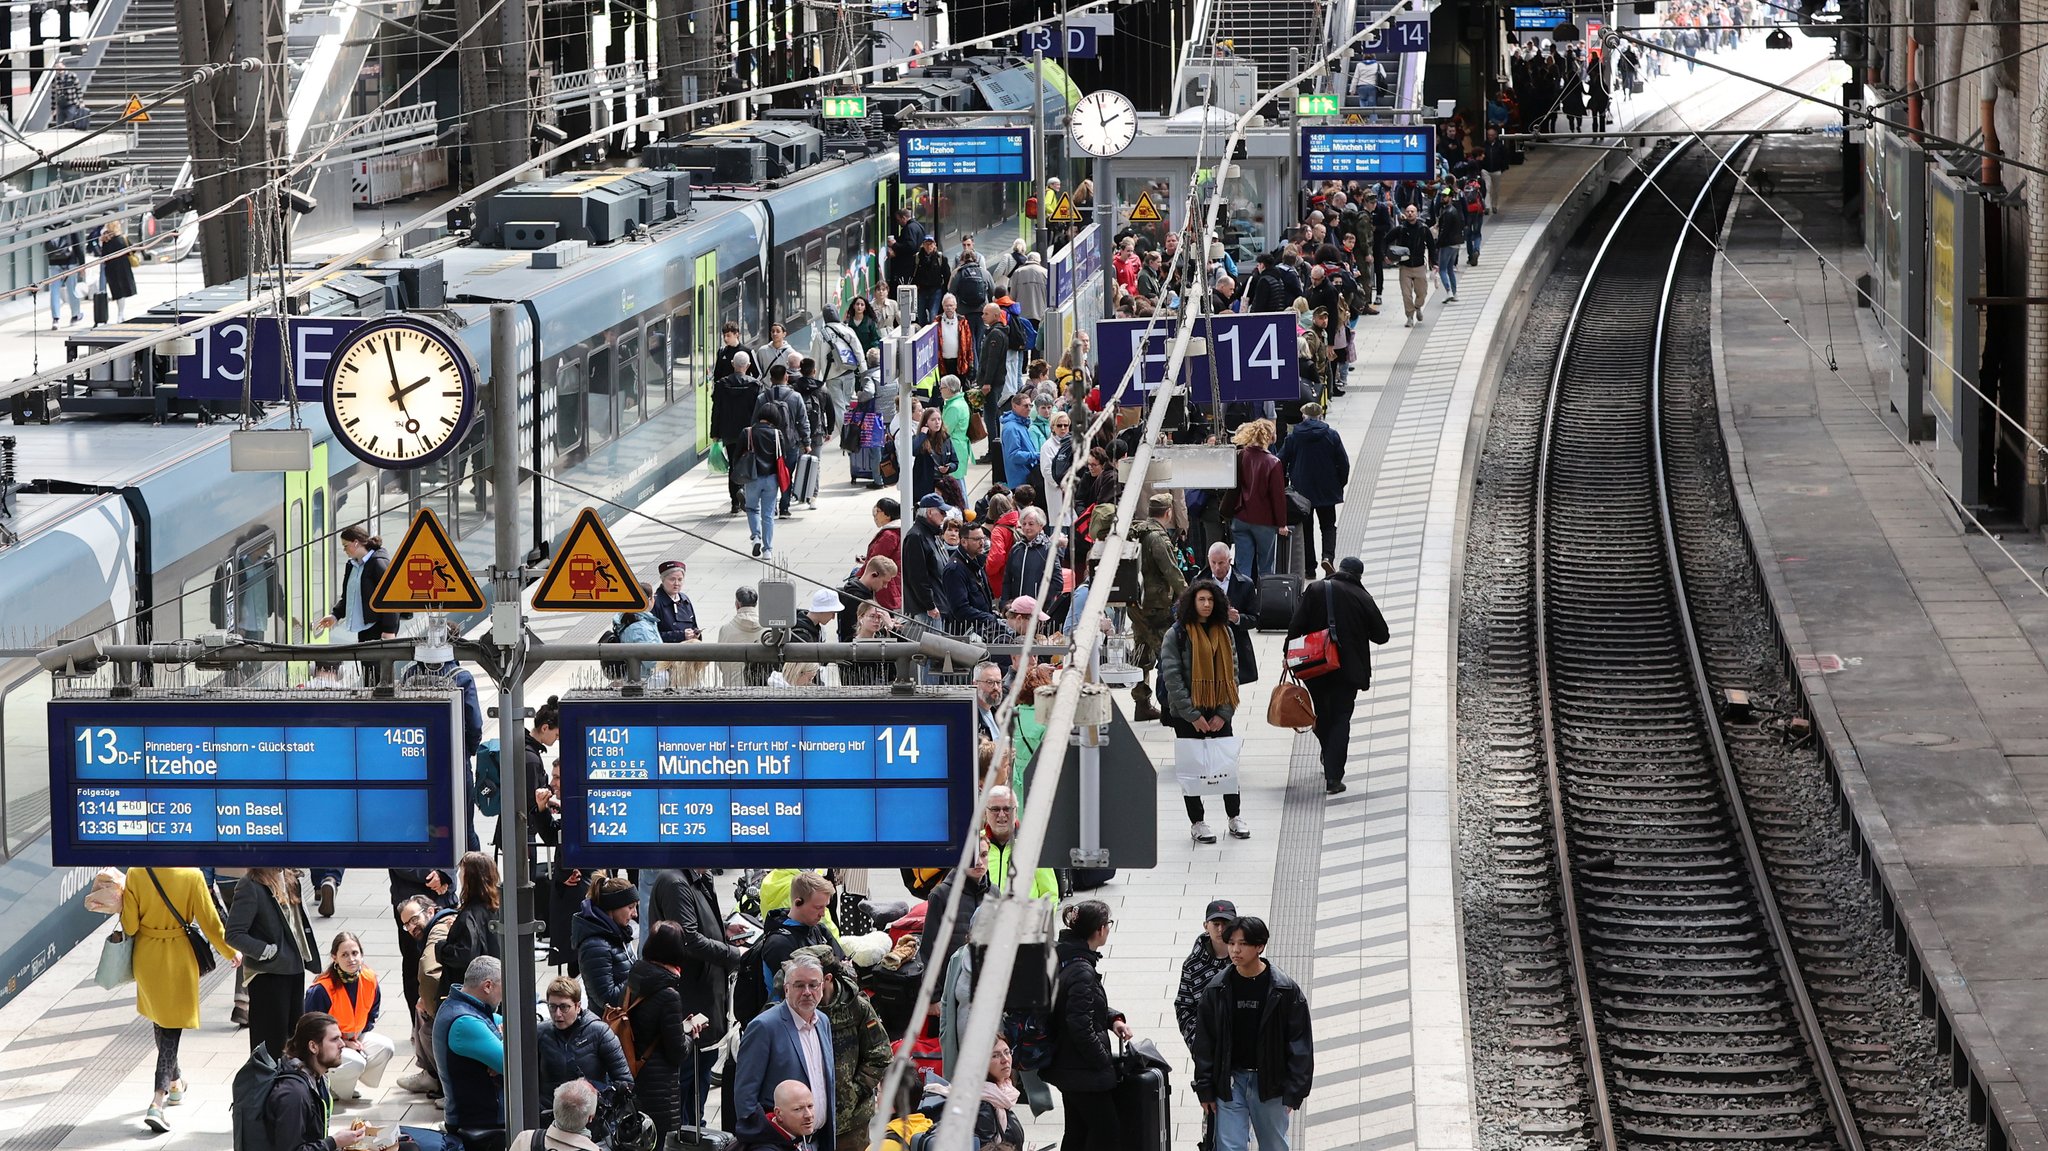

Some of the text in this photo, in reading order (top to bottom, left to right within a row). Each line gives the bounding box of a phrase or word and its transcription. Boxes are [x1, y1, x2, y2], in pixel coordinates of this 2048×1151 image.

[1030, 28, 1085, 52] 13 D
[1398, 23, 1424, 46] 14
[907, 138, 922, 151] 13
[1403, 134, 1418, 148] 14
[195, 324, 334, 386] 13 E
[1131, 323, 1286, 391] E 14
[226, 562, 234, 598] 2
[384, 729, 424, 745] 14:06
[588, 728, 629, 745] 14:01
[77, 728, 141, 765] 13 D-F
[145, 742, 193, 753] Pinneberg
[203, 742, 248, 752] Elmshorn
[258, 742, 315, 752] Glückstadt
[401, 747, 425, 757] RB61
[588, 746, 624, 757] ICE 881
[658, 742, 706, 751] Hannover
[709, 741, 727, 751] Hbf
[737, 741, 768, 751] Erfurt
[771, 741, 789, 751] Hbf
[799, 741, 846, 753] Nürnberg
[848, 741, 865, 751] Hbf
[877, 727, 920, 764] 14
[146, 756, 217, 774] Itzehoe
[659, 755, 790, 775] München Hbf
[77, 788, 120, 796] Folgezüge
[78, 801, 283, 816] 13:14 +60 ICE 206 von Basel
[589, 802, 802, 816] 14:12 ICE 1079 Basel Bad
[79, 821, 284, 835] 13:36 +45 ICE 374 von Basel
[589, 822, 770, 836] 14:24 ICE 375 Basel
